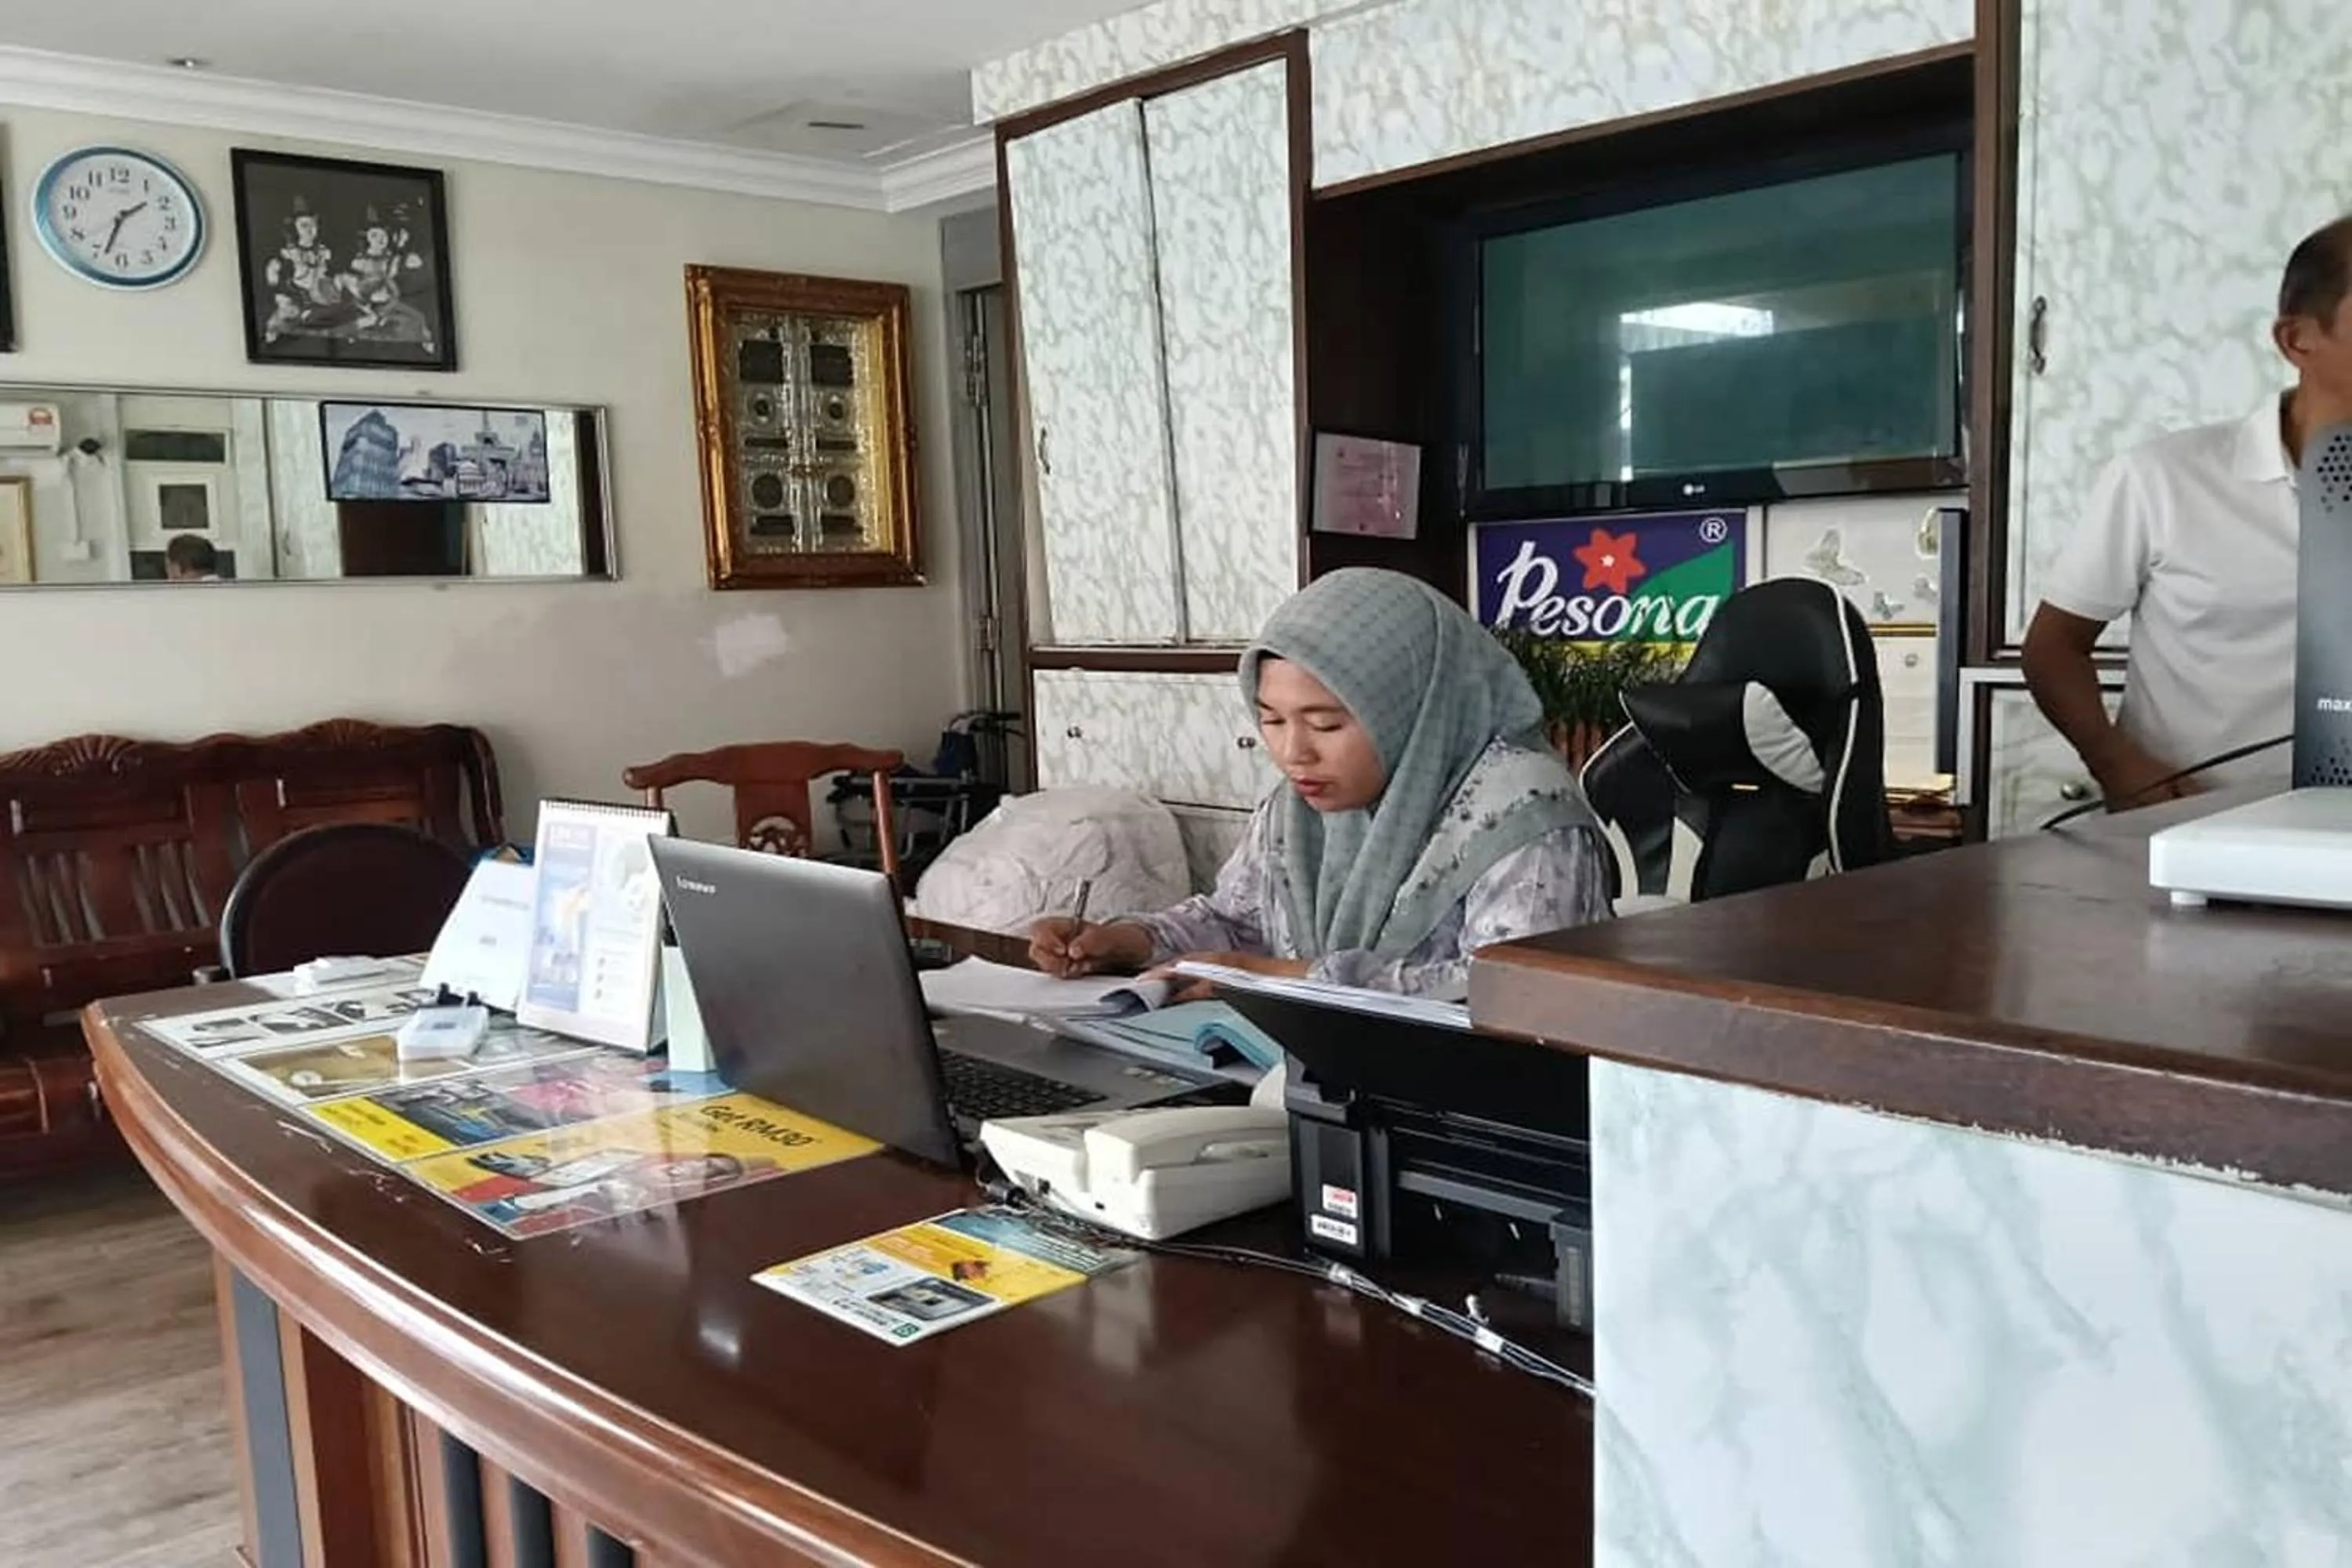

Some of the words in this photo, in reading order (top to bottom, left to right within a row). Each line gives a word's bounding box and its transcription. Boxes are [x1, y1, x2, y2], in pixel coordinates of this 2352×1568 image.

[111, 168, 130, 183] 12
[70, 185, 90, 200] 10
[1496, 540, 1721, 637] Pesona
